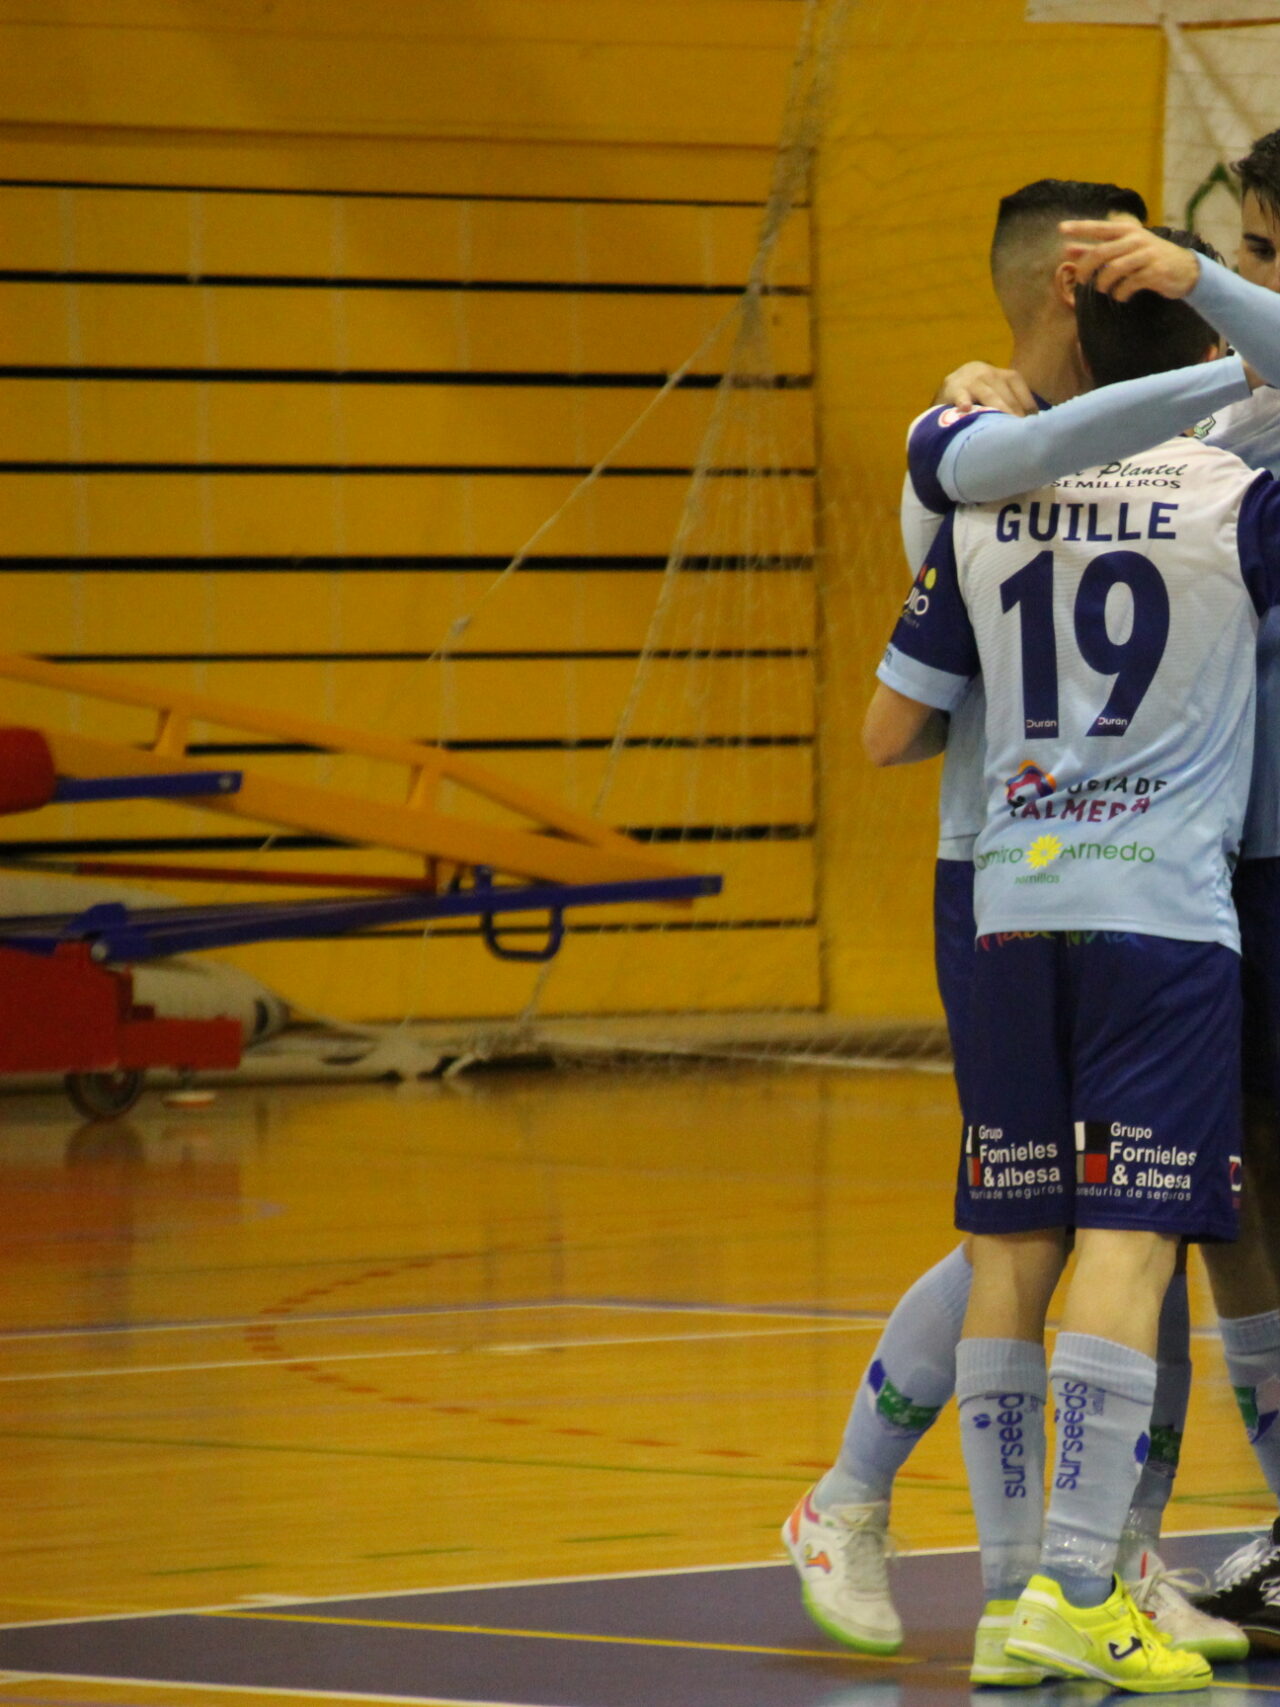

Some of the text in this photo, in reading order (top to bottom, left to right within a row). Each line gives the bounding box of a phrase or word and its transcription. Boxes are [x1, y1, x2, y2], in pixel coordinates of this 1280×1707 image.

[1097, 461, 1189, 479] Plantel
[1052, 479, 1181, 489] SEMILLEROS
[996, 502, 1179, 542] GUILLE
[1000, 550, 1170, 739] 19
[1060, 842, 1155, 863] Arnedo
[1110, 1121, 1152, 1141] Grupo
[1110, 1141, 1198, 1167] Fornieles
[983, 1165, 1061, 1187] & albesa
[1112, 1163, 1192, 1190] & albesa
[1007, 1184, 1063, 1200] seguros
[1126, 1186, 1142, 1199] de
[1056, 1381, 1088, 1490] surseeds
